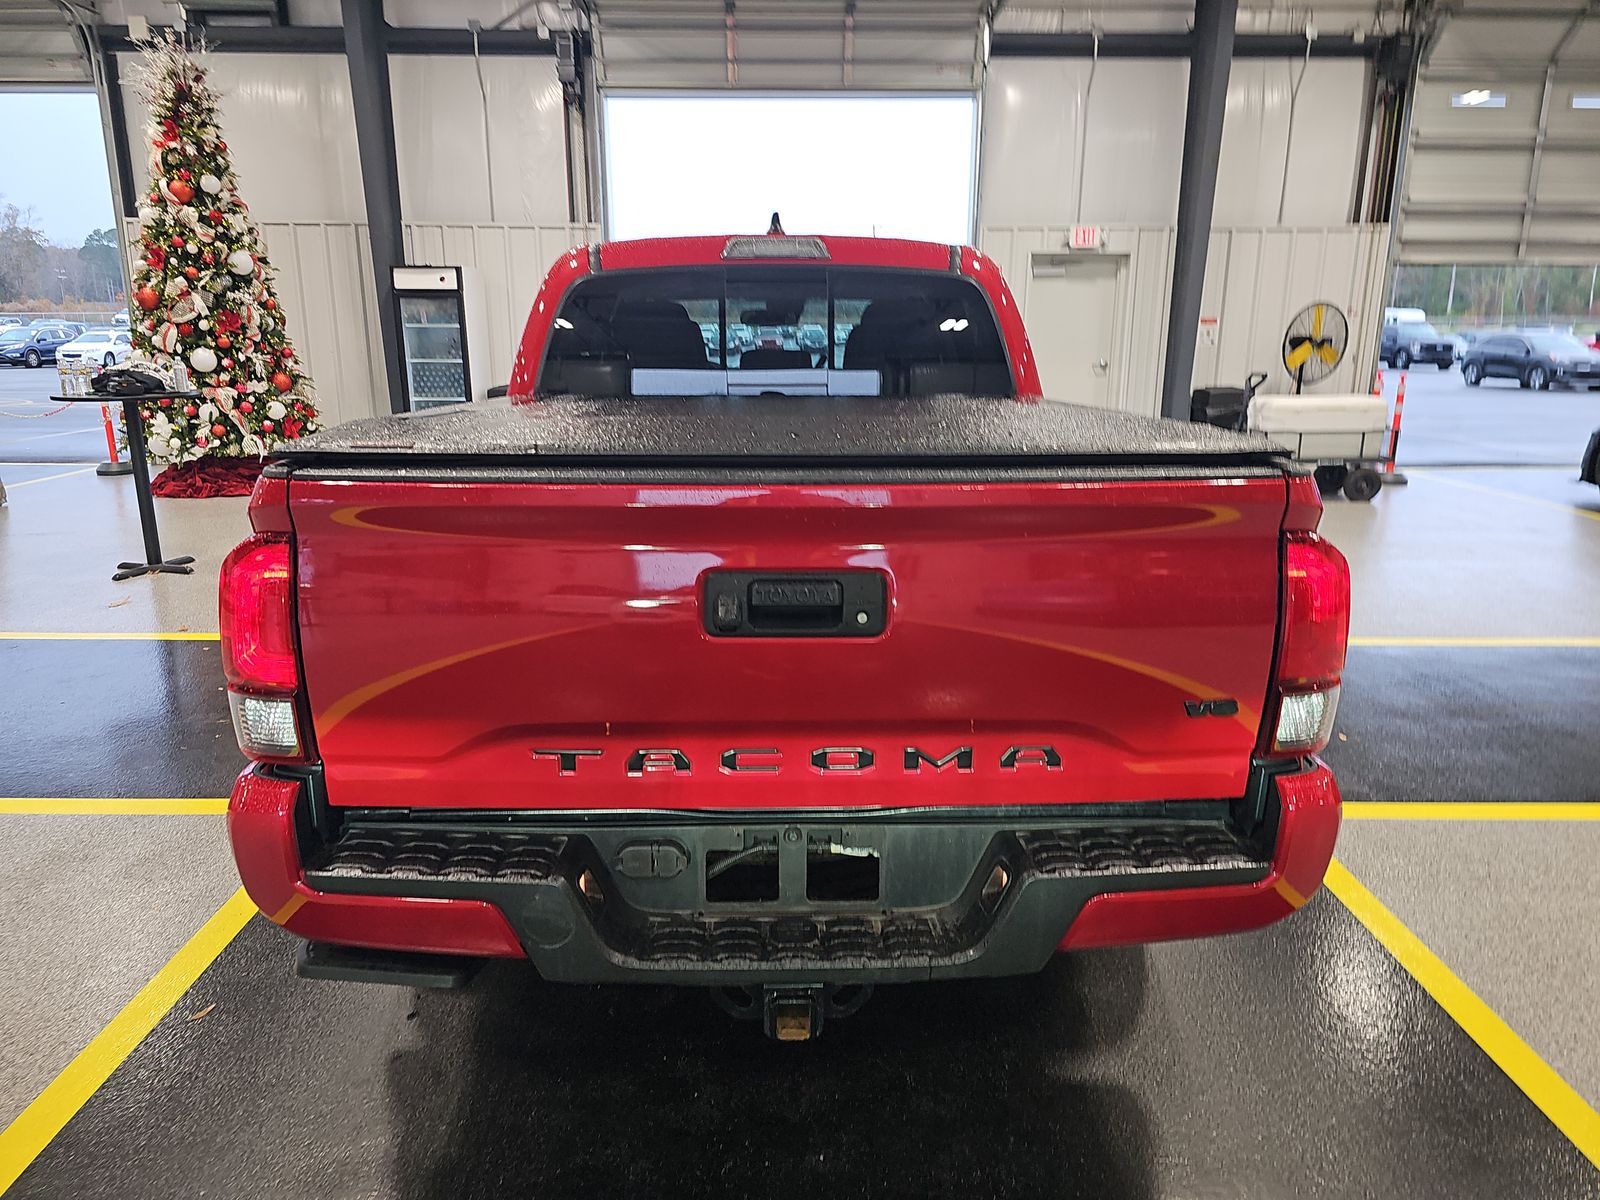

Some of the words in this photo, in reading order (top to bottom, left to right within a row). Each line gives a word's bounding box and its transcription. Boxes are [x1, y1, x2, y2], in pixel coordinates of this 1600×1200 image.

[1074, 225, 1096, 247] EXIT
[757, 585, 834, 603] TOYOTA
[531, 745, 1065, 777] TACOMA
